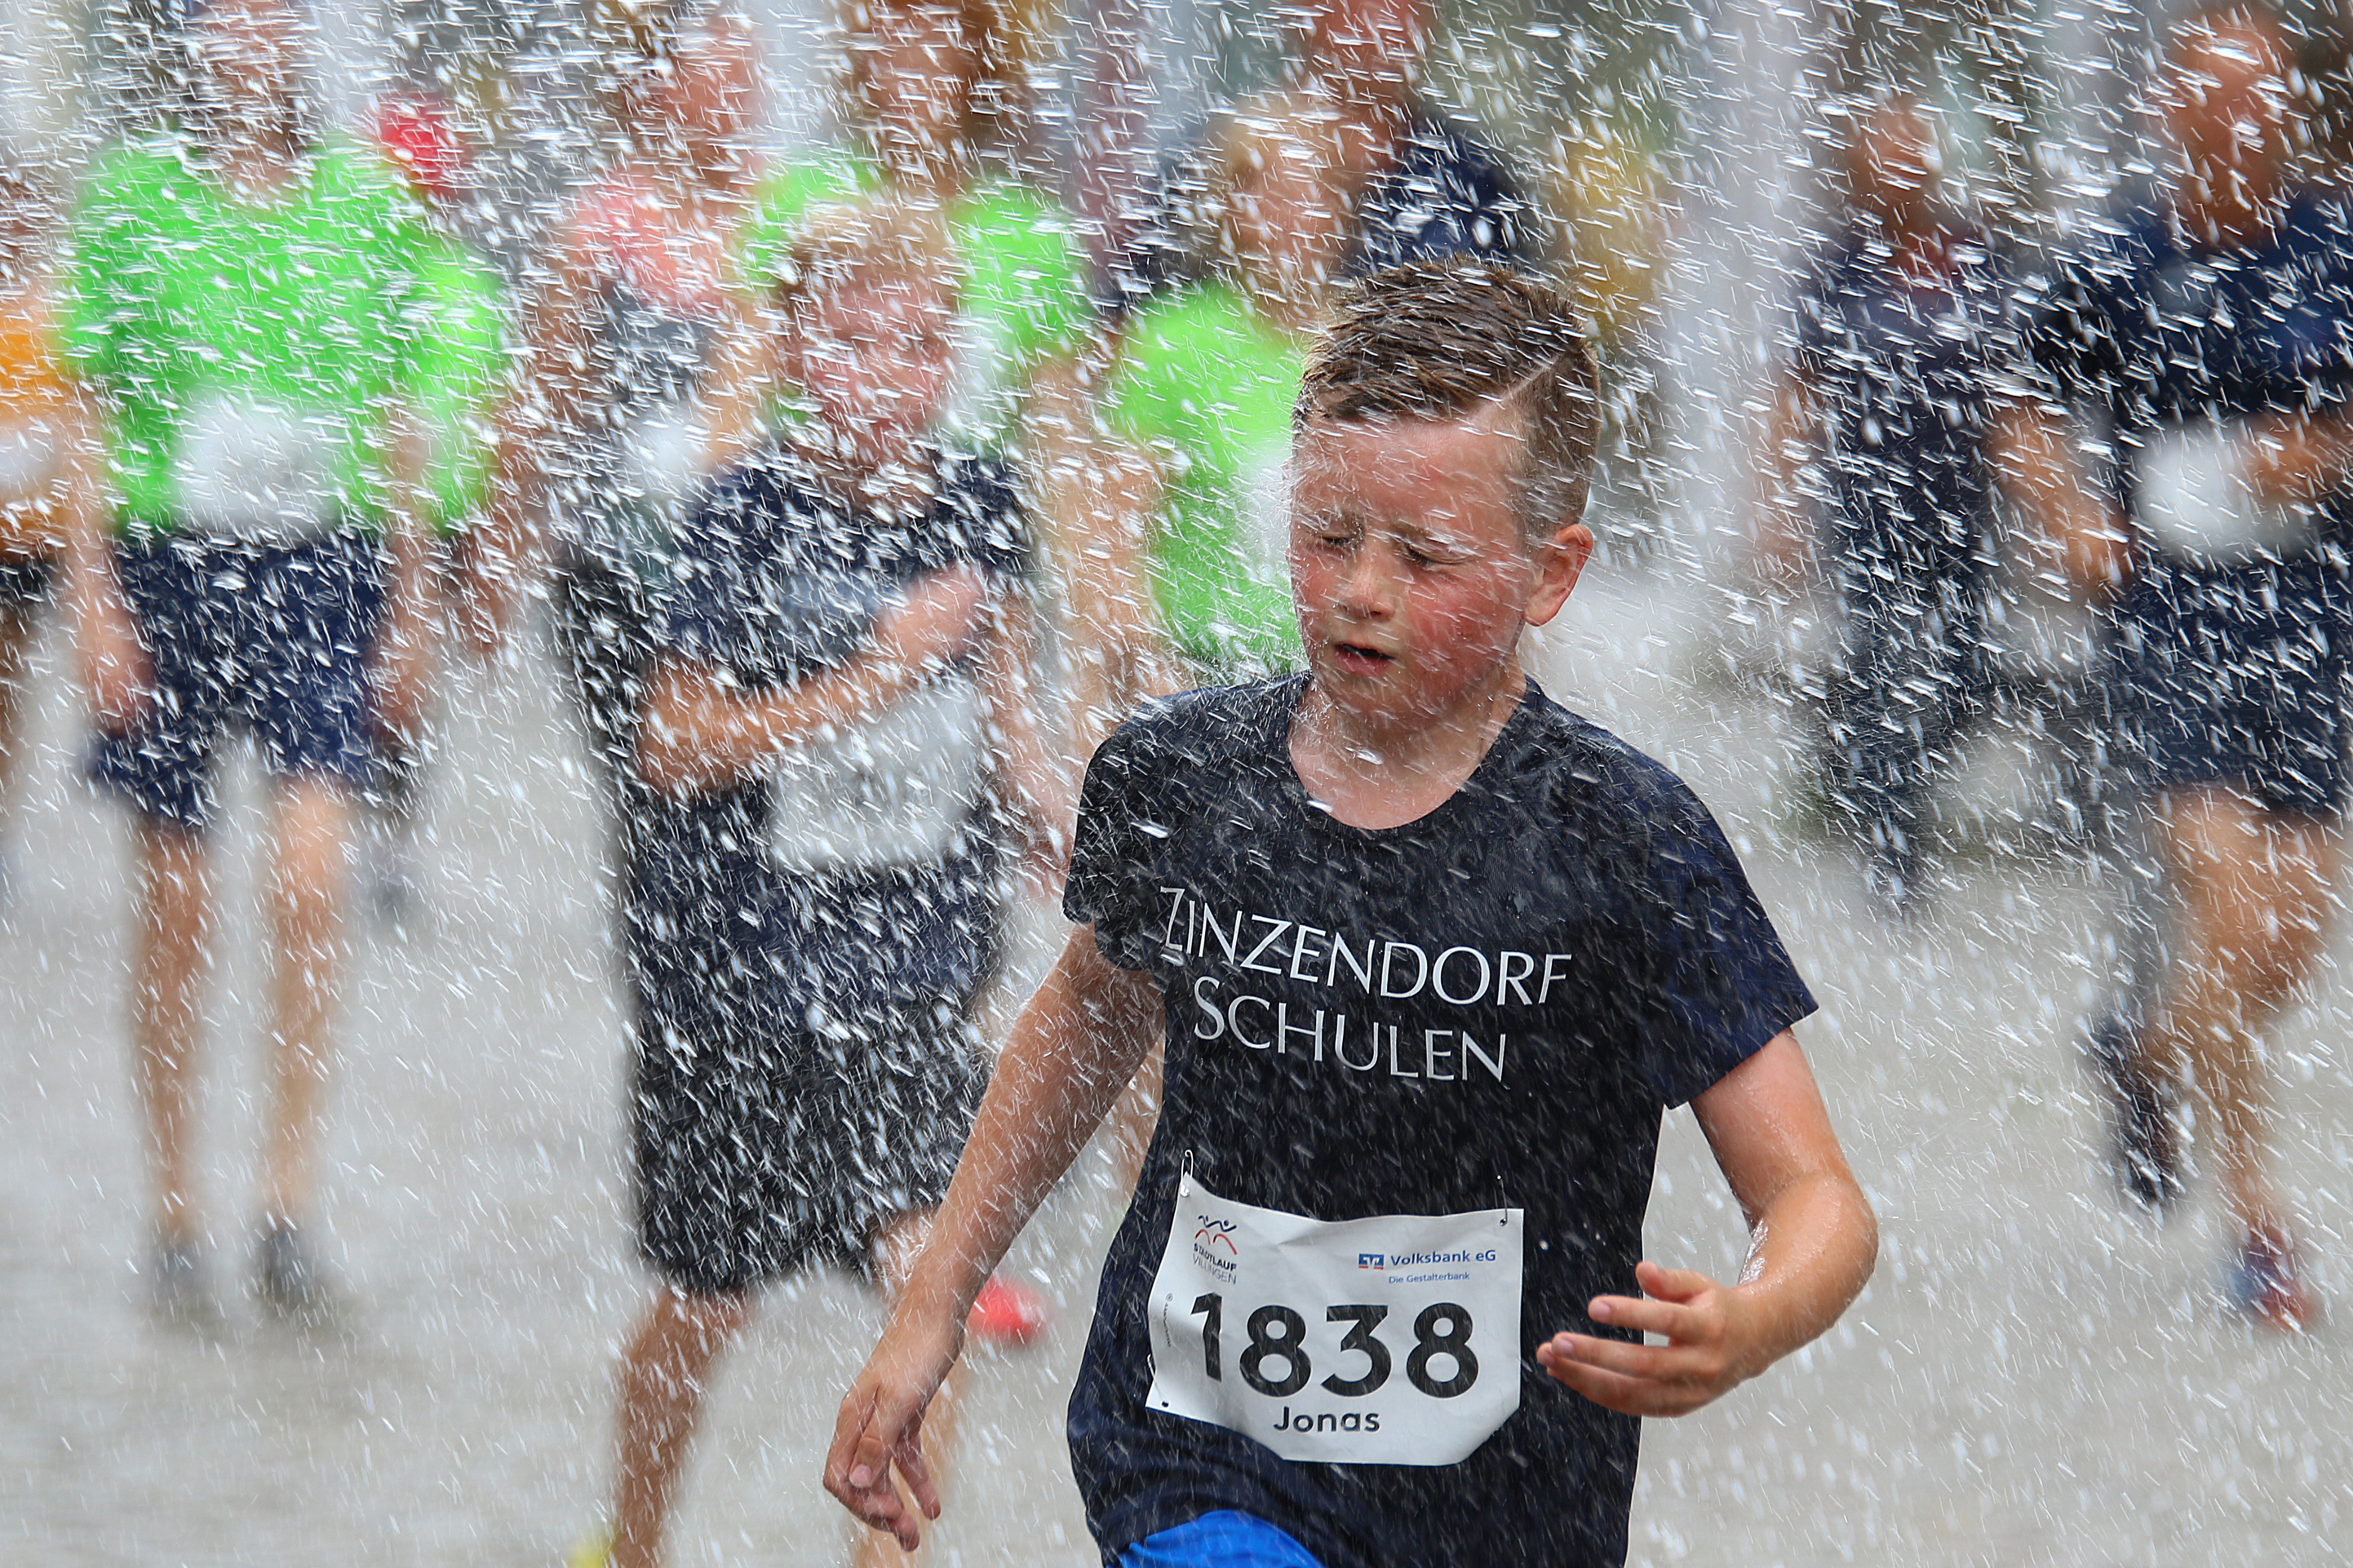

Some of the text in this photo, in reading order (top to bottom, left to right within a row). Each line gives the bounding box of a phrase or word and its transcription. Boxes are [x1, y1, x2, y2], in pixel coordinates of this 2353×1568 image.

[1159, 885, 1572, 1006] ZINZENDORF
[1193, 976, 1507, 1082] SCHULEN
[1192, 1253, 1237, 1285] VILLINGEN
[1194, 1242, 1237, 1271] STADTLAUF
[1390, 1249, 1496, 1266] Volksbank eG
[1388, 1272, 1471, 1284] Die Gestalterbank
[1190, 1292, 1479, 1399] 1838
[1273, 1406, 1381, 1433] Jonas
